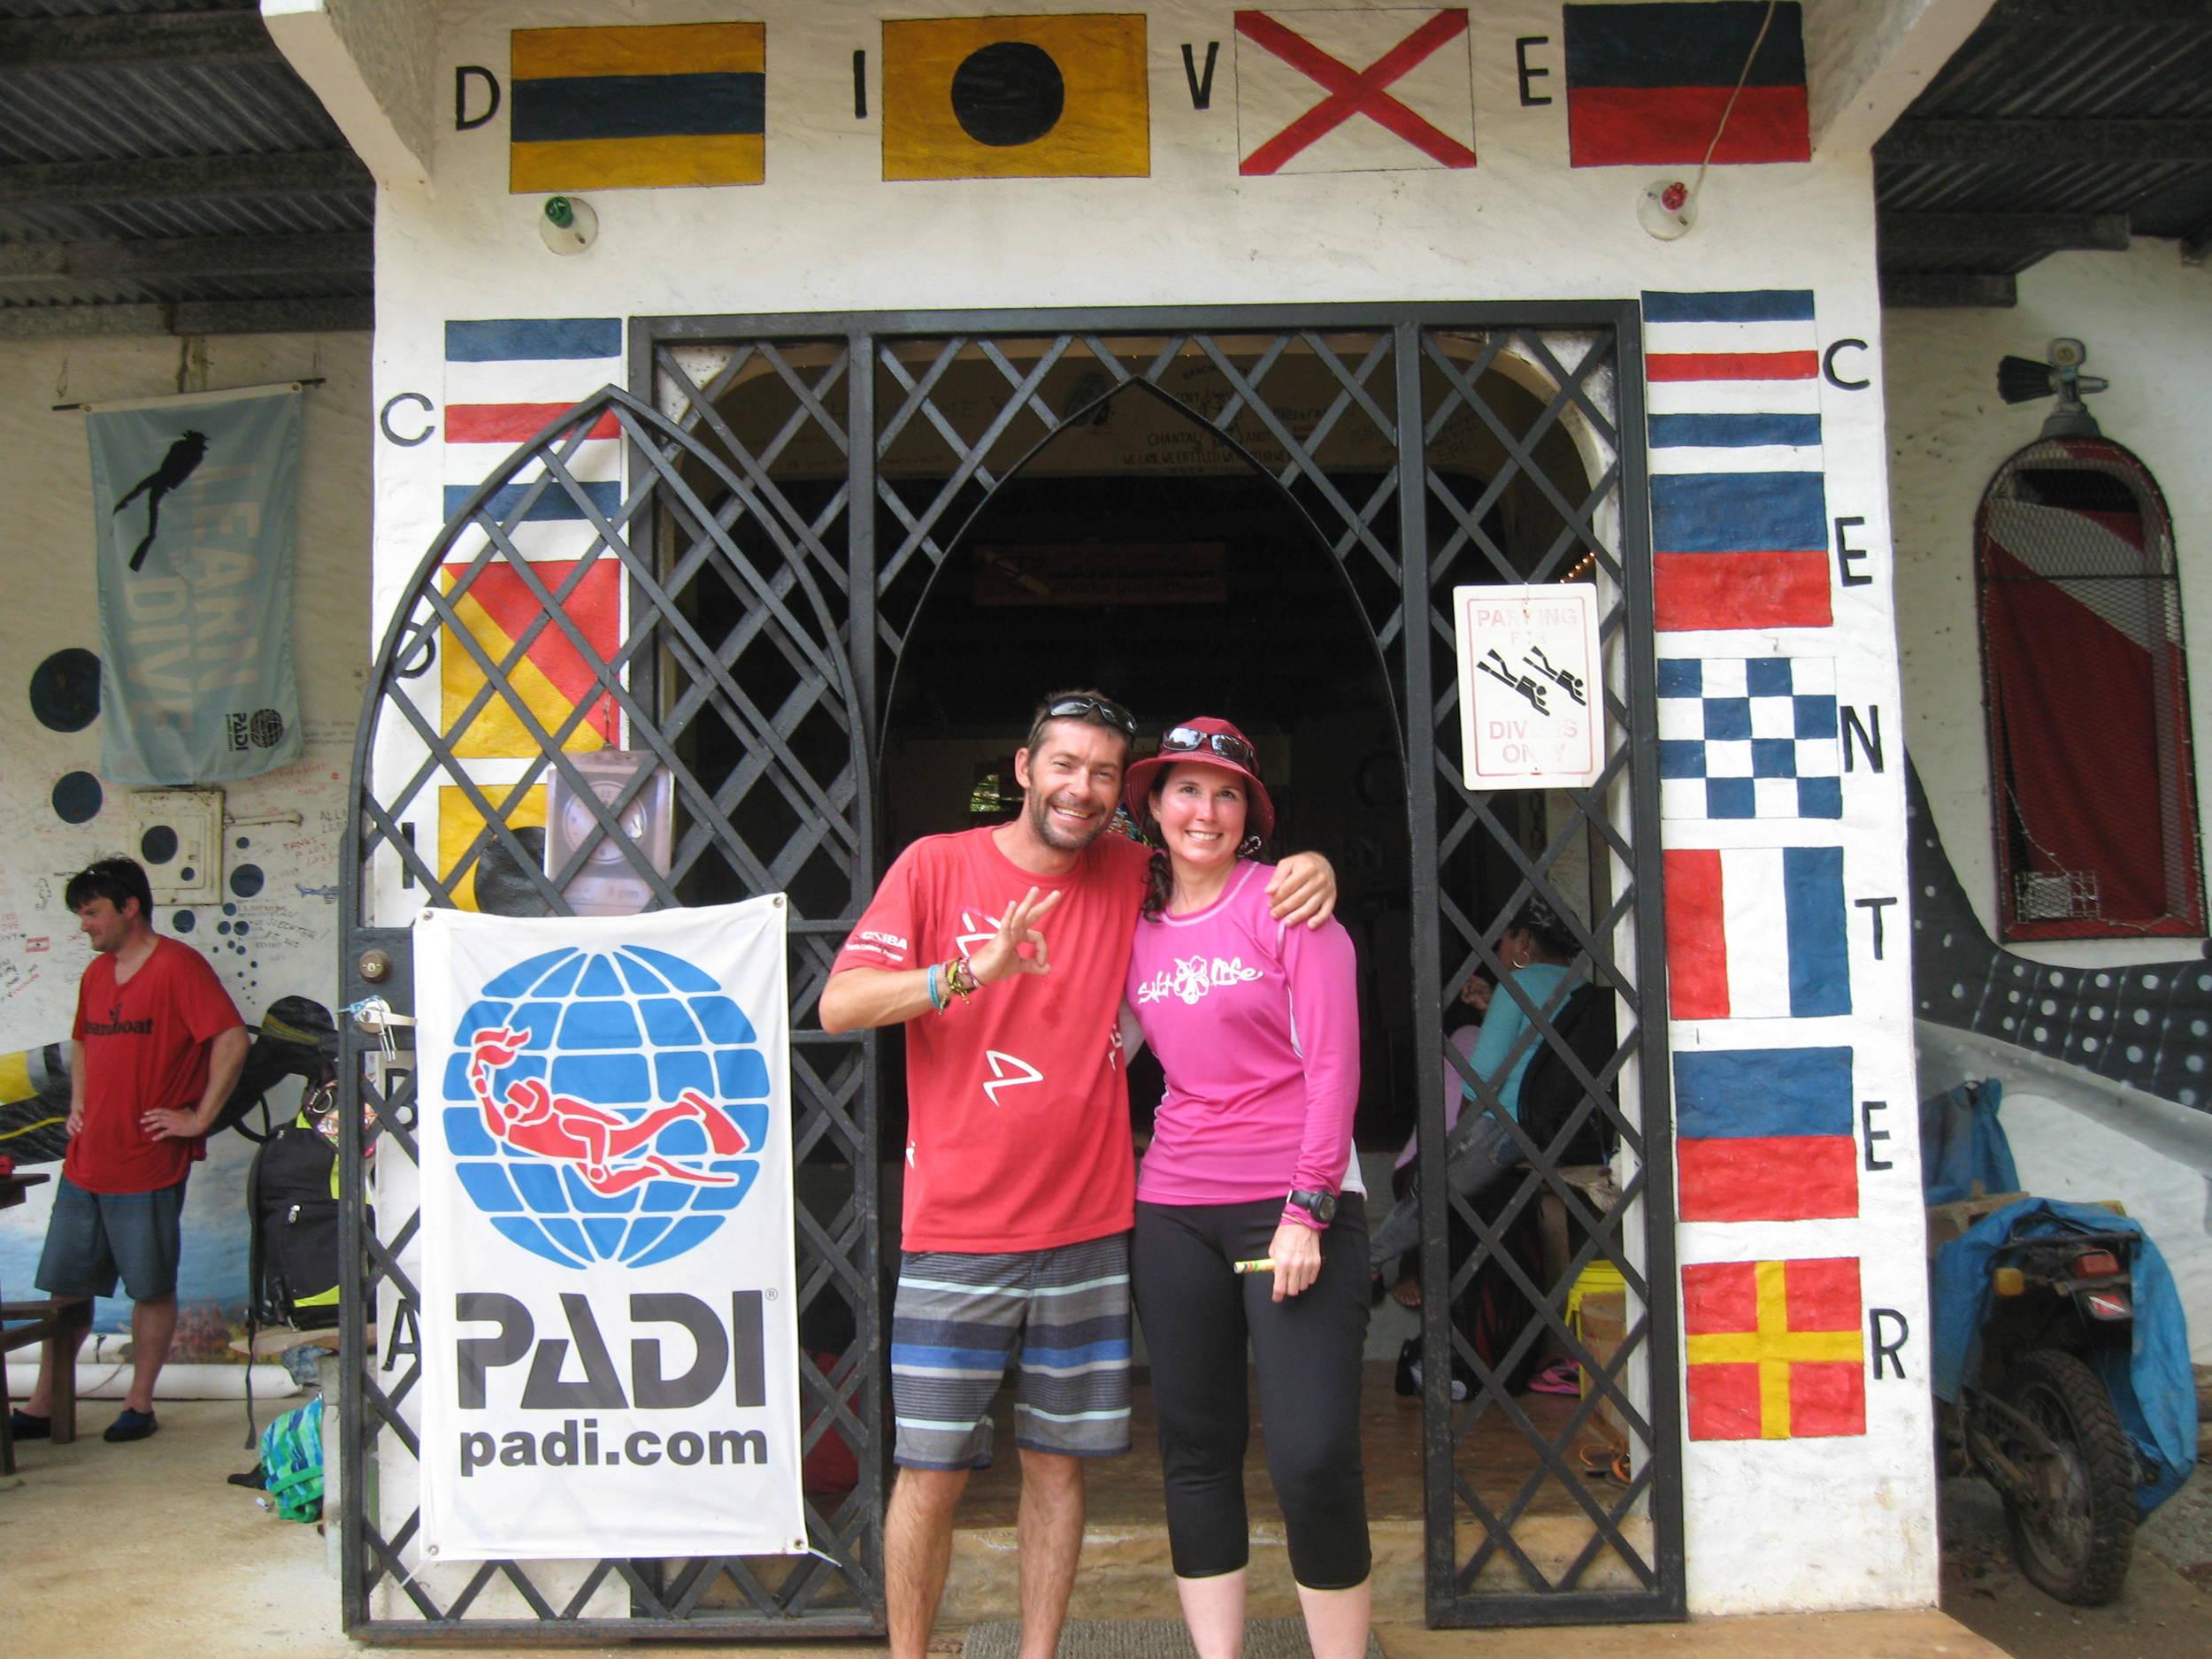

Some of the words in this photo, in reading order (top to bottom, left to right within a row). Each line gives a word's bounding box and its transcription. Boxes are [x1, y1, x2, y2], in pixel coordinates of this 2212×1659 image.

[456, 65, 501, 131] D
[1181, 42, 1220, 110] V
[1516, 35, 1554, 107] E
[1823, 337, 1870, 391] C
[380, 393, 435, 446] C
[1834, 516, 1873, 588] E
[1477, 608, 1578, 628] PARING
[232, 711, 250, 752] PADI
[1488, 719, 1578, 741] DIVS
[1502, 742, 1569, 764] ONY
[1839, 704, 1885, 774] N
[1854, 896, 1897, 961] T
[1861, 1100, 1893, 1172] E
[456, 1289, 766, 1410] PADI
[1868, 1308, 1909, 1380] R
[458, 1417, 769, 1478] padi.com
